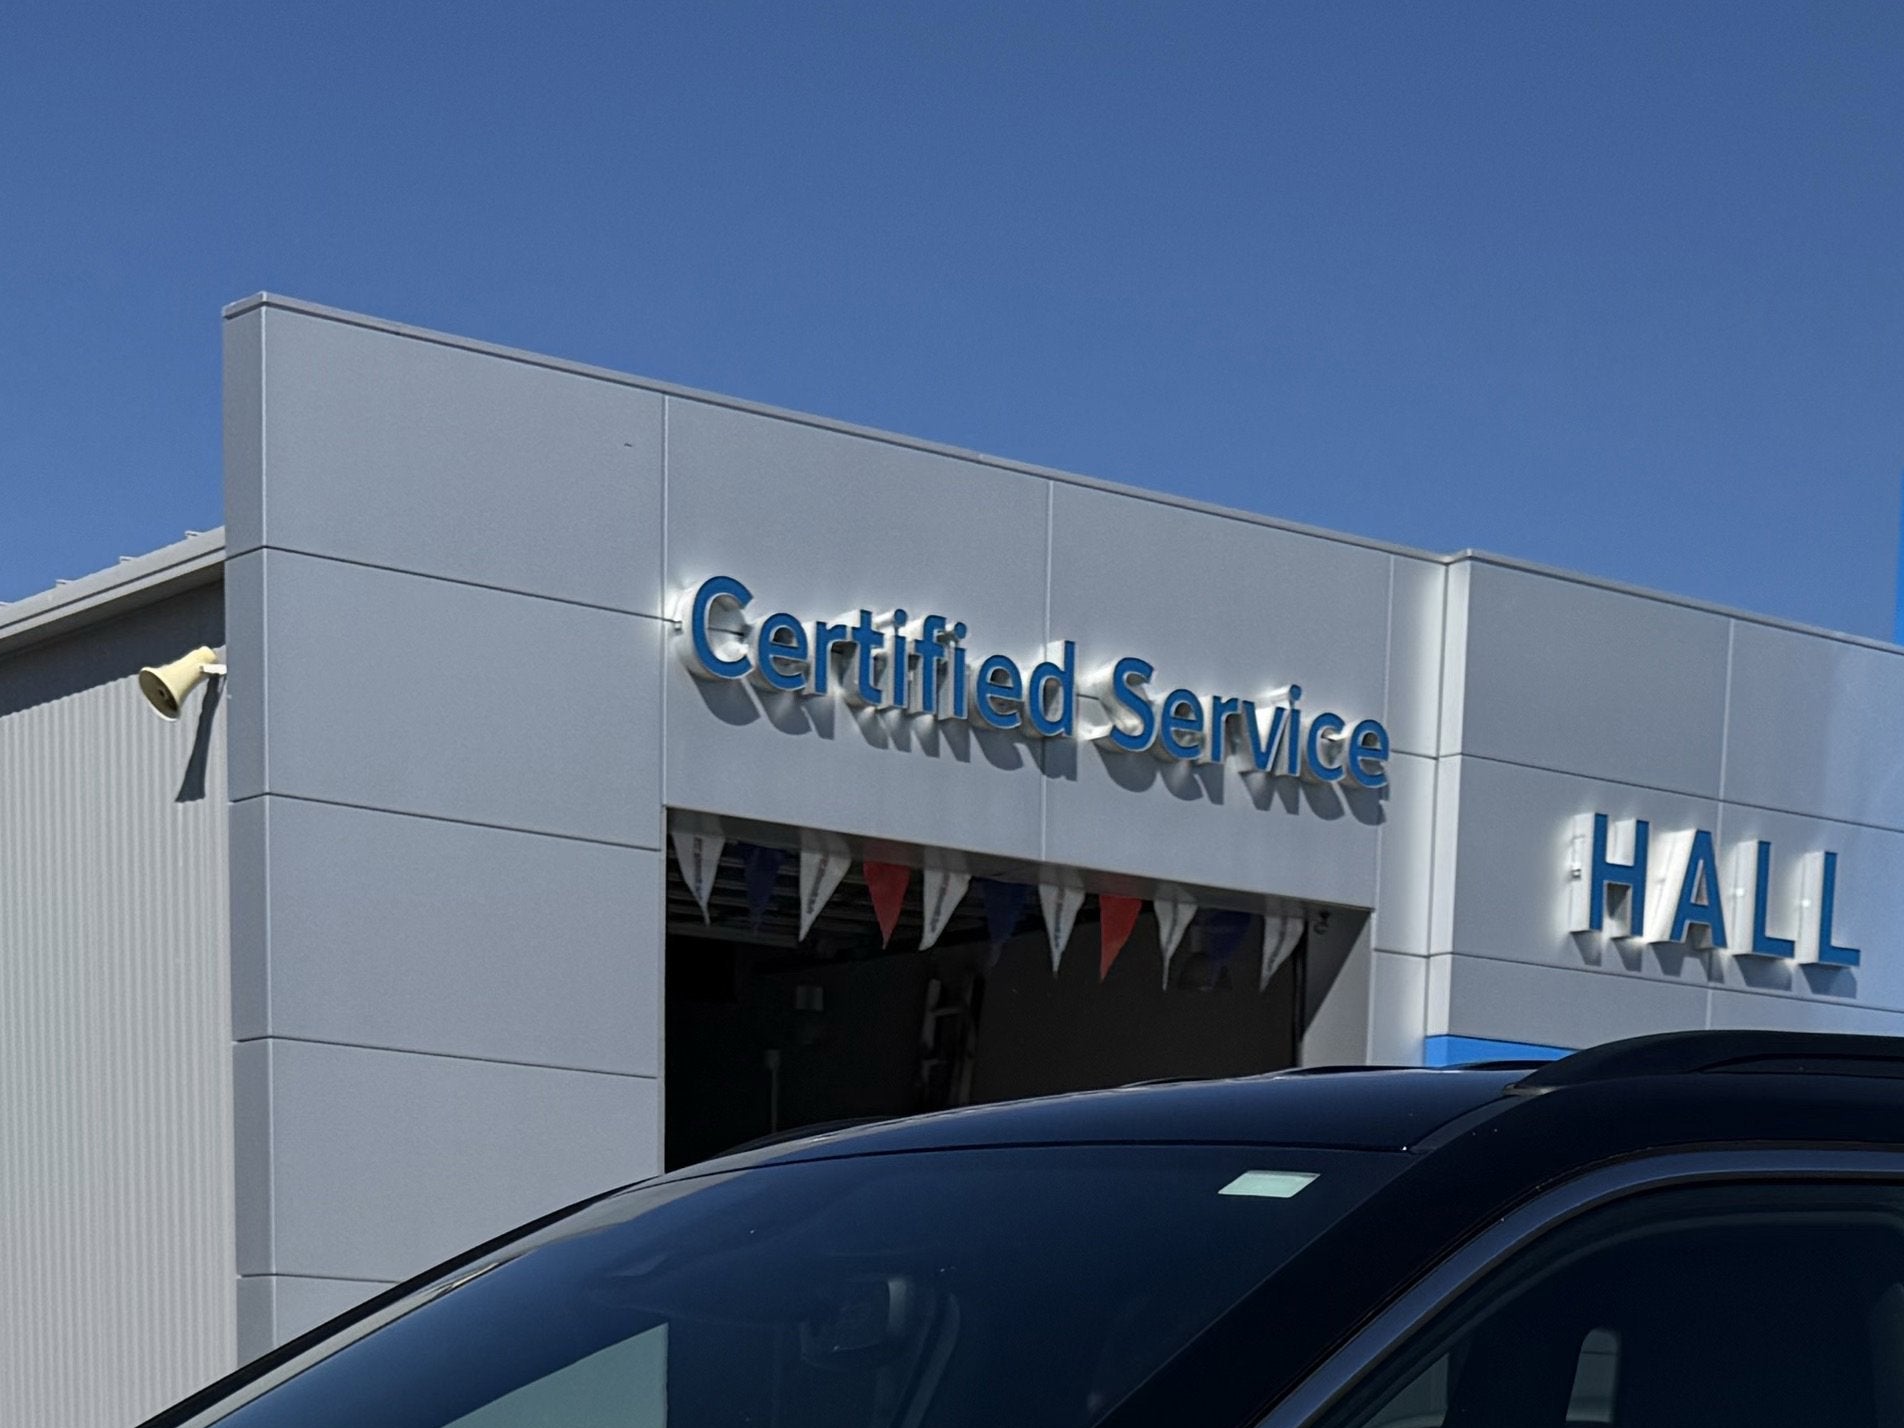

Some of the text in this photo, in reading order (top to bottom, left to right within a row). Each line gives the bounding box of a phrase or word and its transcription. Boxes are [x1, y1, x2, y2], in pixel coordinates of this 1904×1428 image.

[692, 574, 1391, 791] Certified Service
[1589, 813, 1860, 966] HALL
